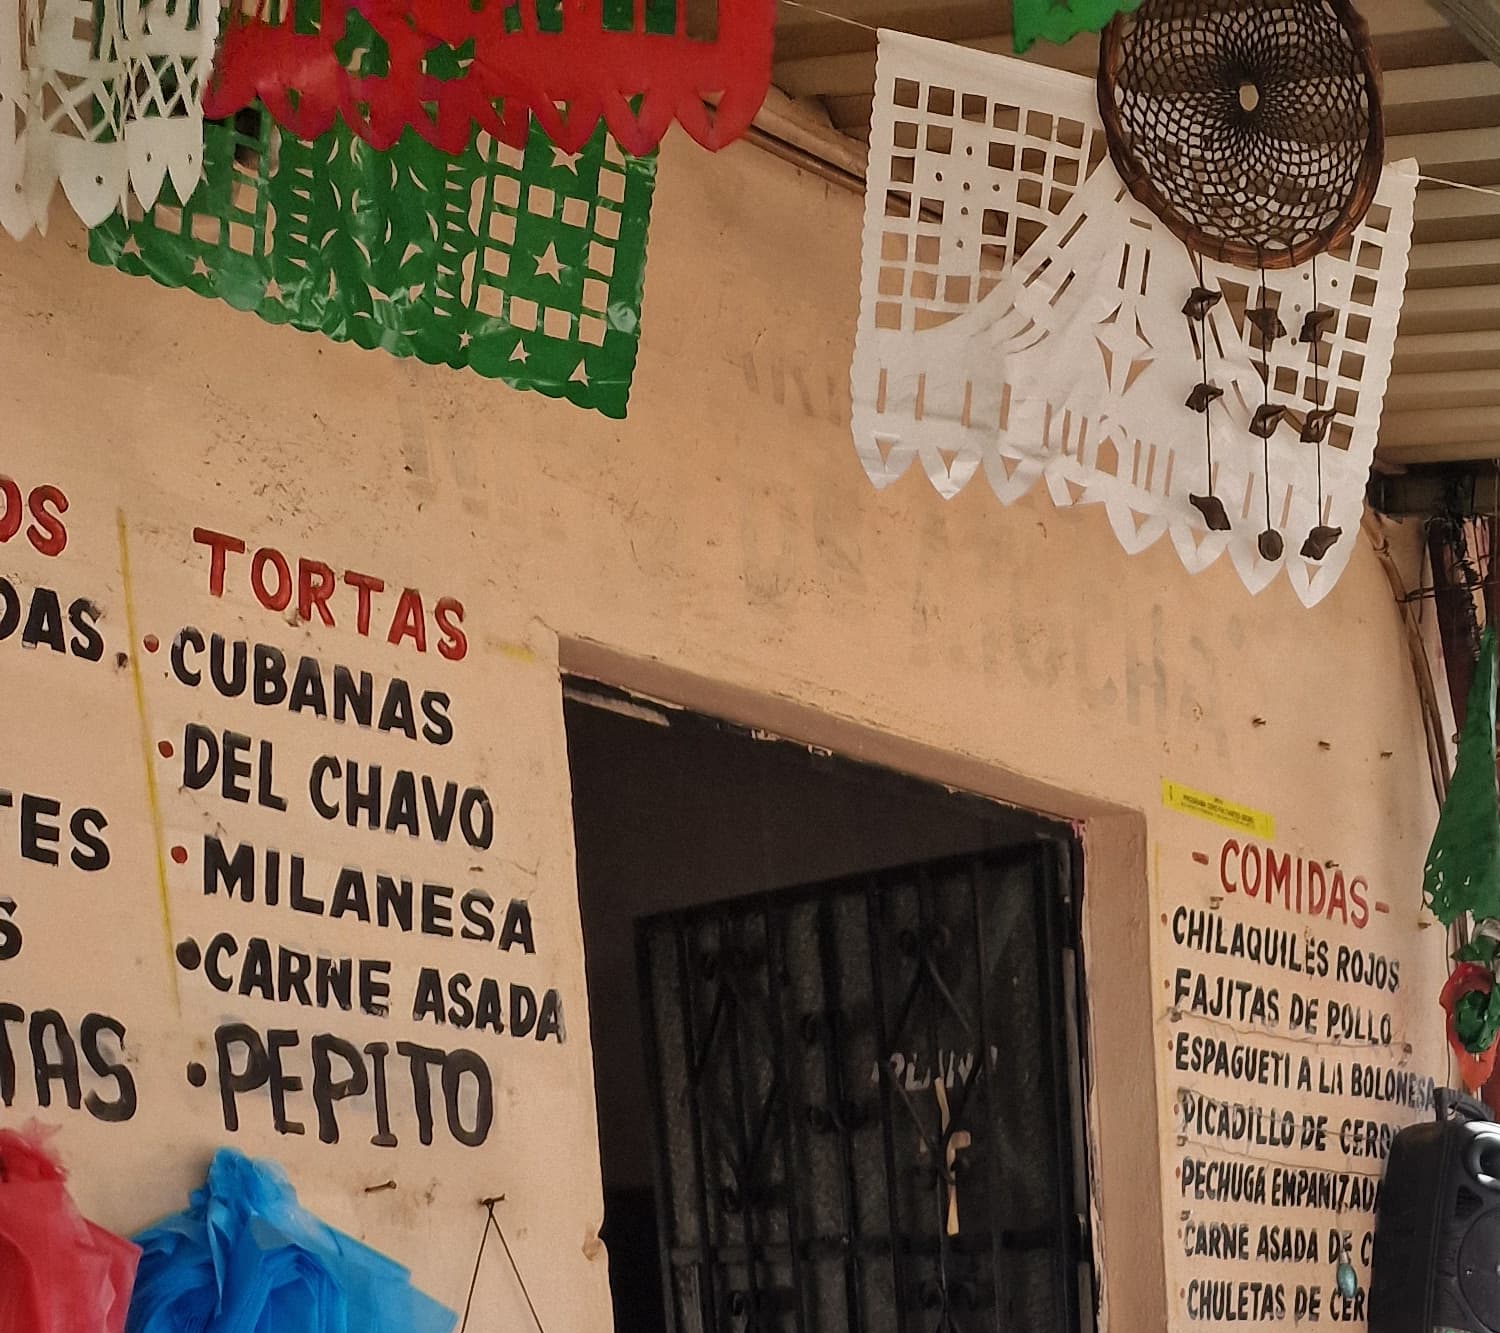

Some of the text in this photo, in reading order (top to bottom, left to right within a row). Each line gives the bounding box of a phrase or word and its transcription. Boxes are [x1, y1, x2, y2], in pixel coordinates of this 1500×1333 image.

[193, 526, 468, 662] TORTAS
[170, 626, 453, 745] CUBANAS
[184, 722, 494, 851] DEL CHAVO
[203, 834, 537, 955] MILANESA
[1220, 839, 1369, 929] COMIDAS
[204, 932, 566, 1044] CARNE ASADA
[1172, 905, 1400, 993] CHILAQUILES ROJOS
[1174, 967, 1392, 1045] FAJITAS DE POLLO
[214, 1022, 493, 1148] PEPITO
[1175, 1032, 1290, 1089] ESPAGUETI
[1297, 1055, 1311, 1092] A
[1319, 1057, 1343, 1096] LA
[1182, 1089, 1295, 1148] PICADILLO
[1301, 1115, 1328, 1151] DE
[1181, 1155, 1266, 1204] PECHUGA
[1184, 1222, 1250, 1261] CARNE
[1256, 1225, 1319, 1264] ASADA
[1328, 1228, 1352, 1265] DE
[1187, 1279, 1286, 1321] CHULETAS
[1294, 1285, 1321, 1325] DE
